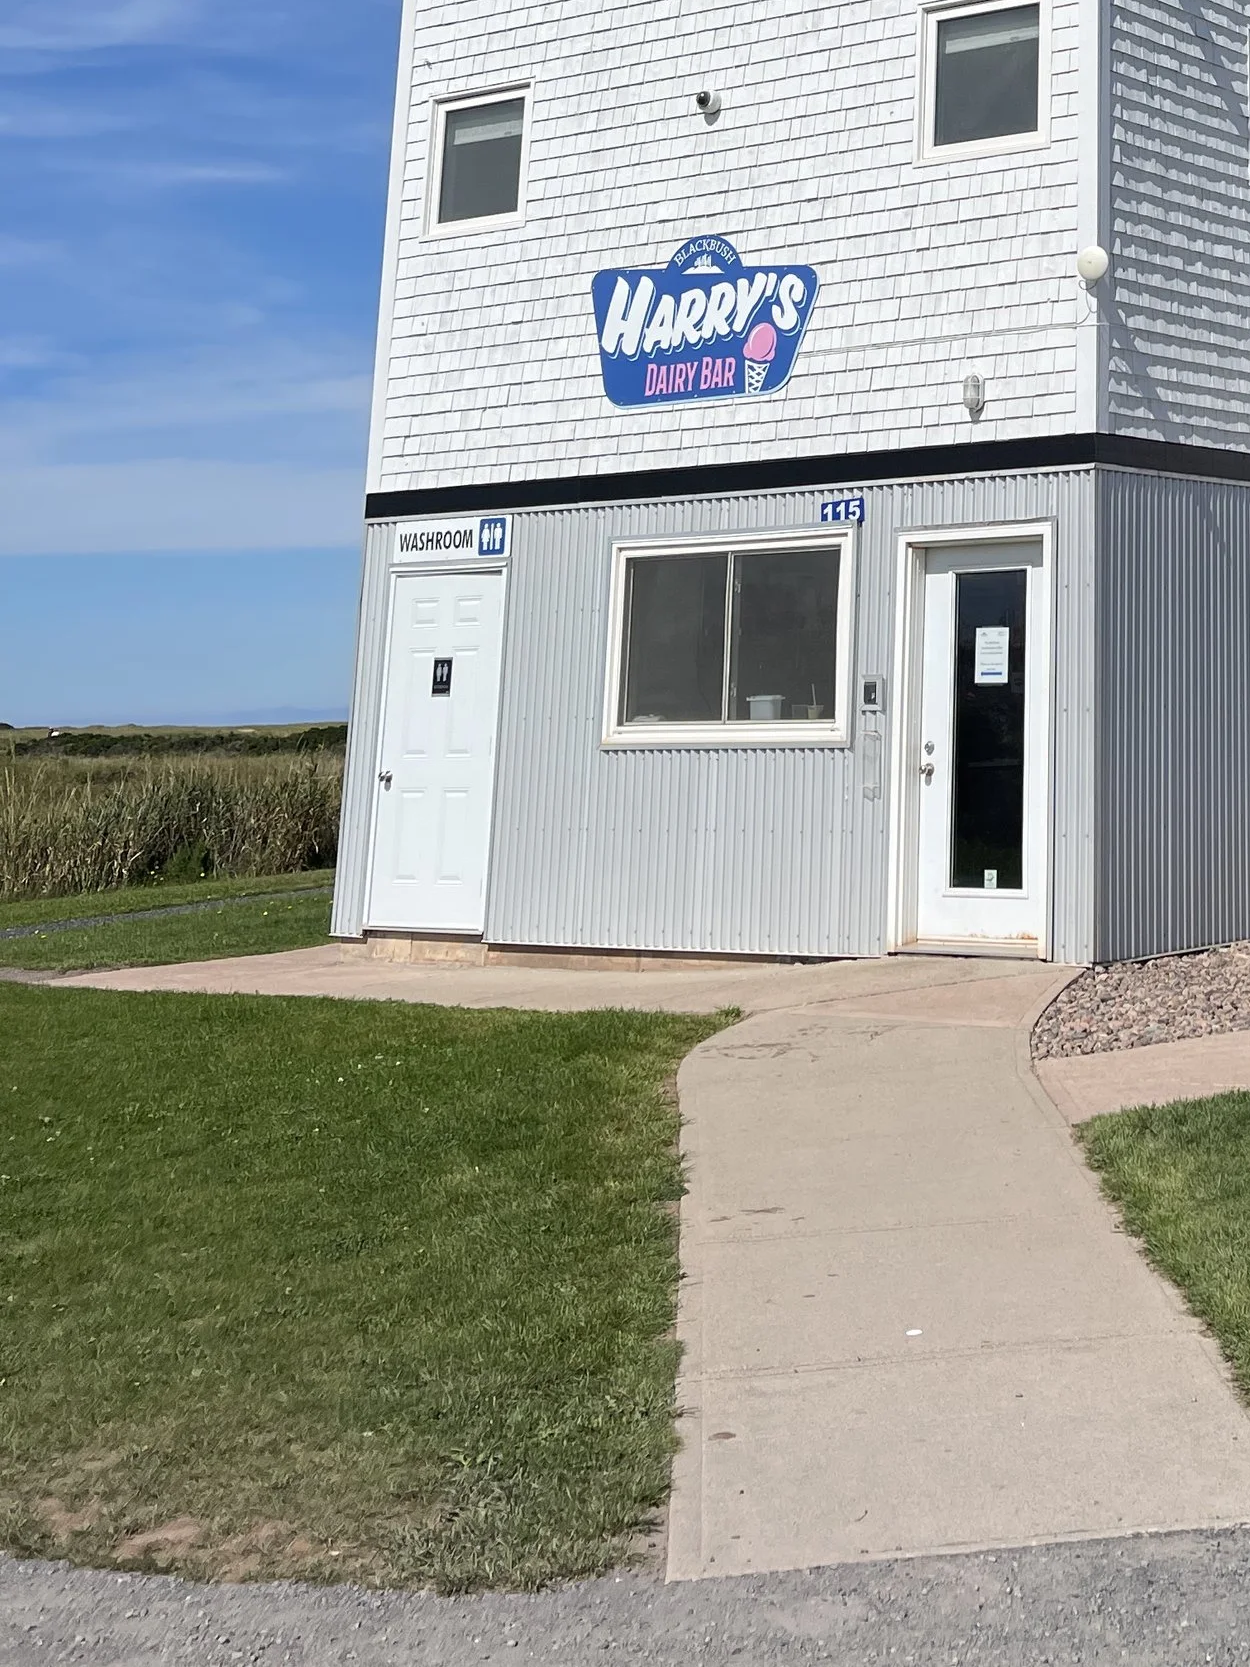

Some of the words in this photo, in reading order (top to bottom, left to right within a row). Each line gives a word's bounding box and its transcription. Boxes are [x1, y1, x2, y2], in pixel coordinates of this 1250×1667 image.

[673, 238, 737, 267] BLACKBUSH
[601, 271, 807, 360] HARRY'S
[644, 360, 699, 397] DAIRY
[700, 356, 736, 390] BAR
[823, 500, 861, 521] 115
[399, 529, 474, 552] WASHROOM
